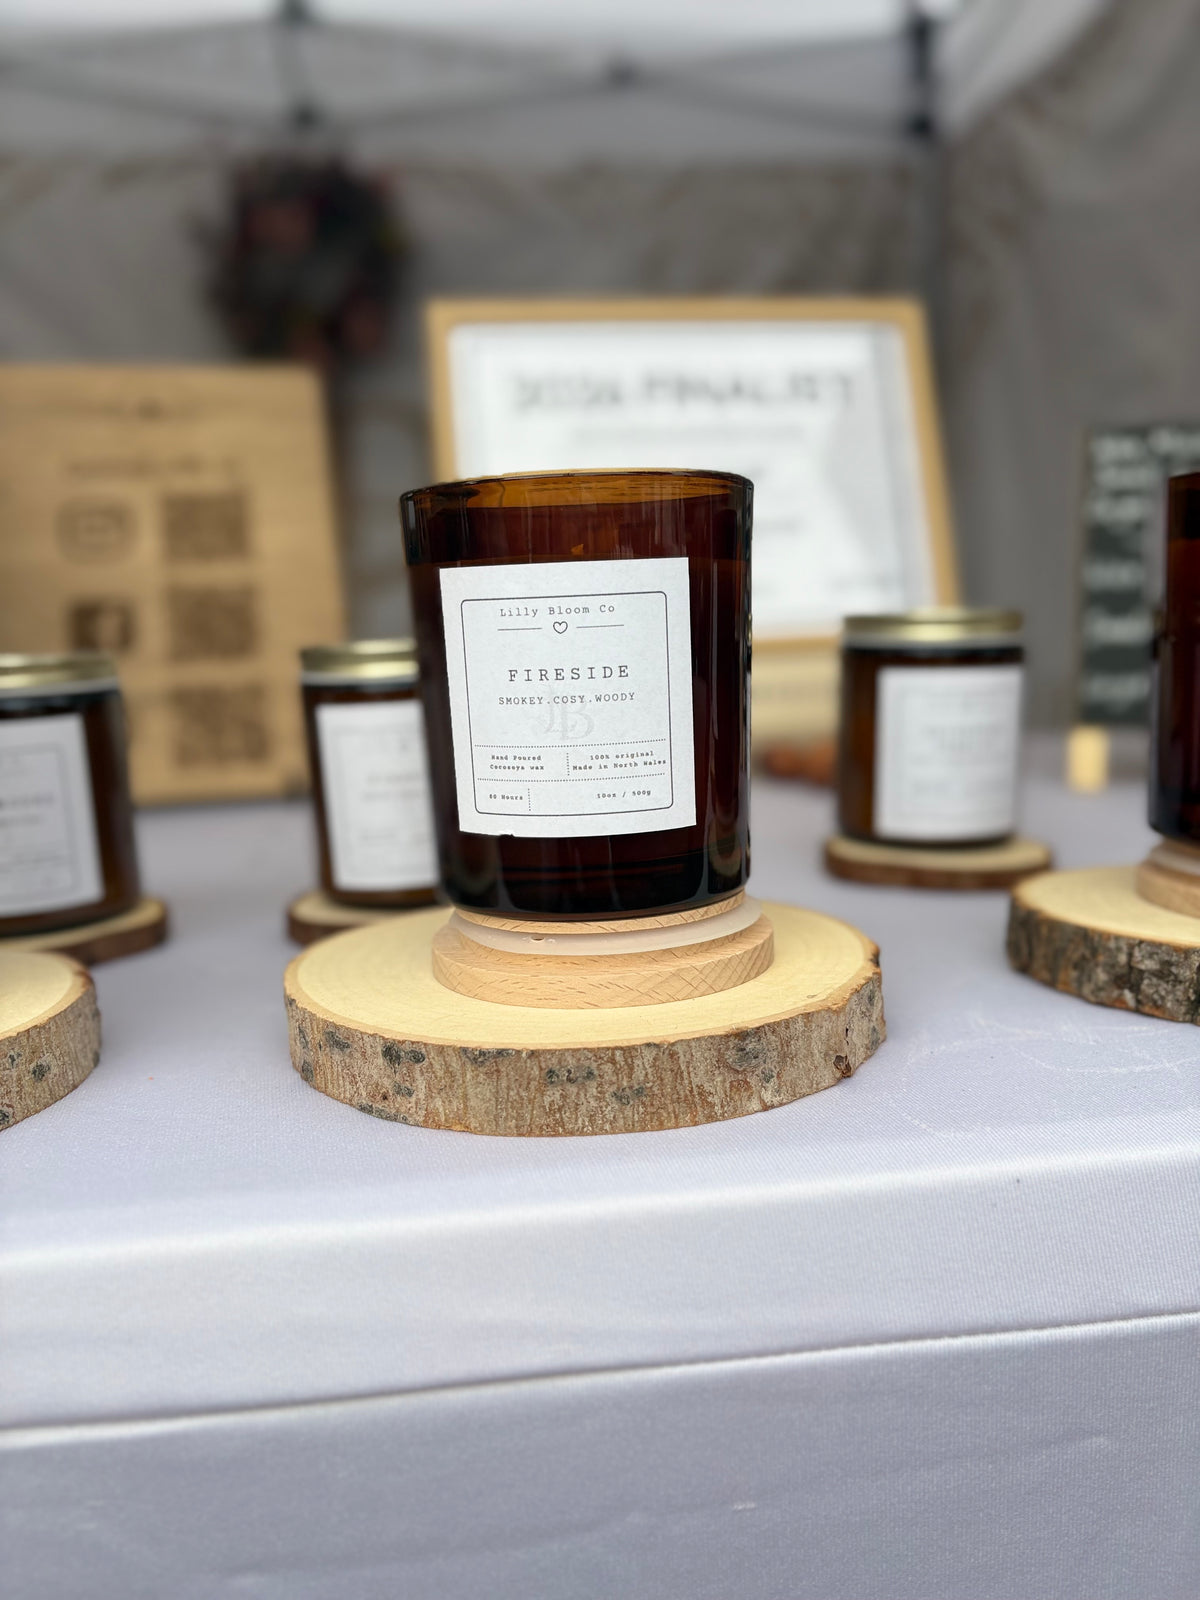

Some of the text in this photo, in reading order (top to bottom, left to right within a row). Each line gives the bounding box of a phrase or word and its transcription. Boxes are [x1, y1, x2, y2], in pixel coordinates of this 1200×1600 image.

[500, 604, 616, 617] Lilly Bloom Co
[508, 665, 629, 682] FIRESIDE
[615, 750, 654, 759] original
[613, 761, 639, 769] North
